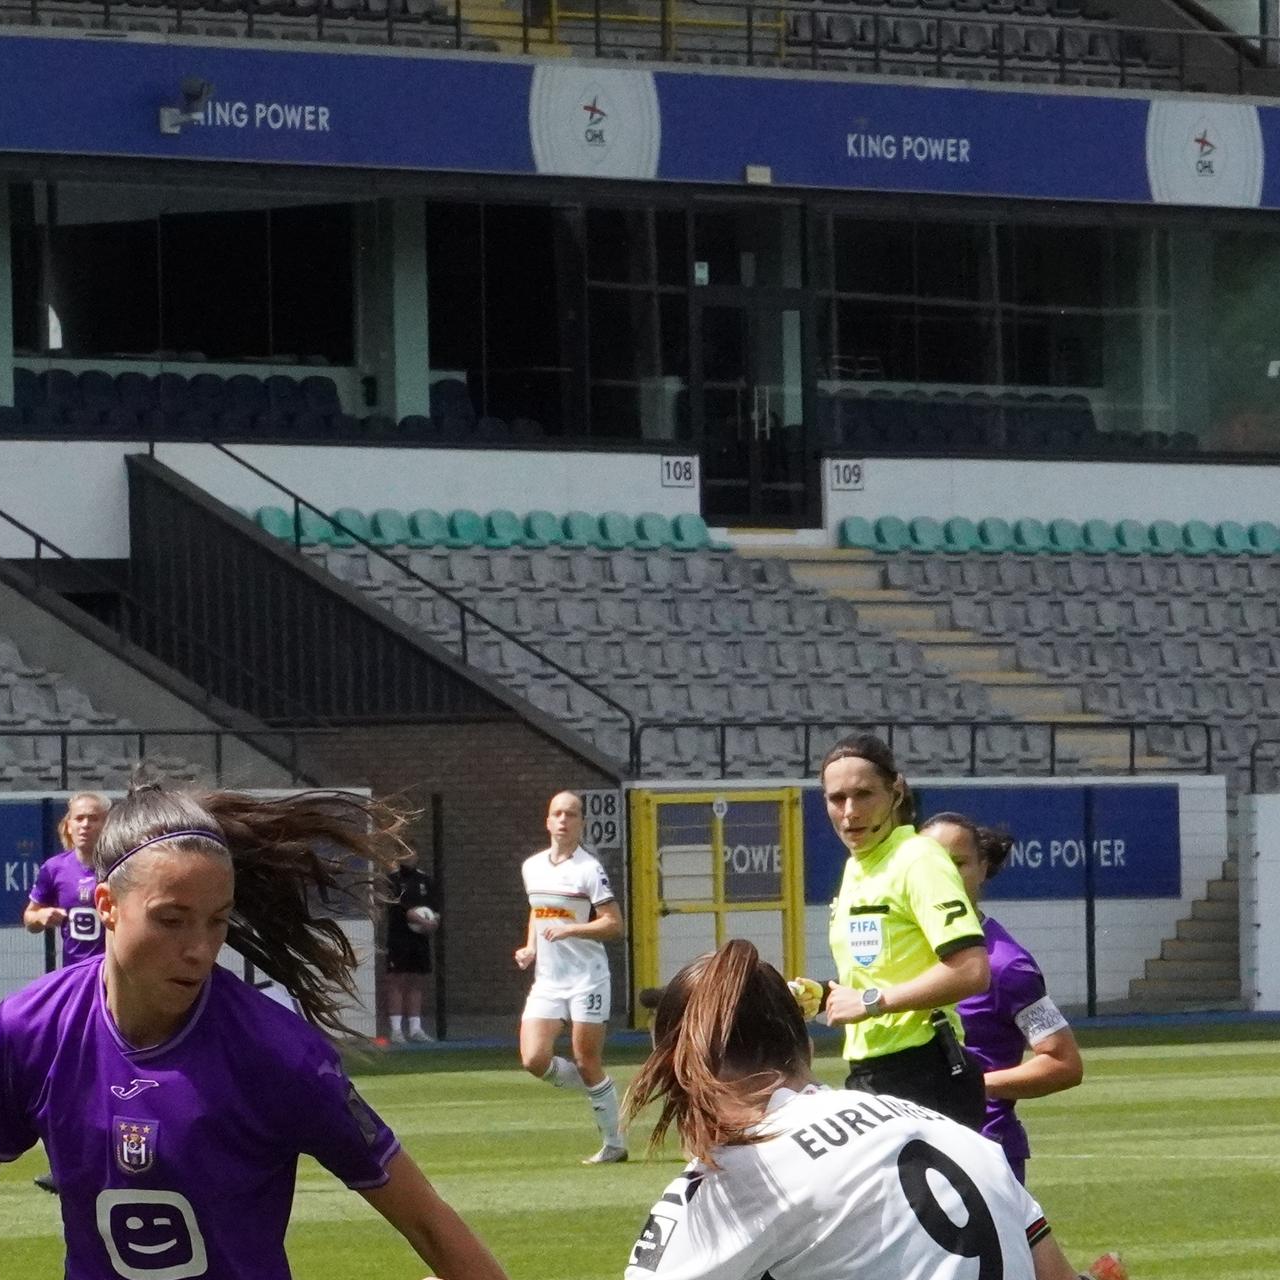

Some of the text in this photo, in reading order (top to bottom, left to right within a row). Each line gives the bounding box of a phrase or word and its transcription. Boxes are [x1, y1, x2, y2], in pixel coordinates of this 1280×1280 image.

[194, 101, 330, 132] ING POWER
[847, 133, 970, 162] KING POWER
[664, 460, 693, 481] 108
[834, 464, 862, 484] 109
[580, 794, 616, 816] 108
[723, 844, 782, 874] POWE
[1010, 840, 1043, 868] NG
[850, 920, 878, 933] FIFA
[850, 939, 879, 947] REFEREE
[586, 993, 602, 1010] 33
